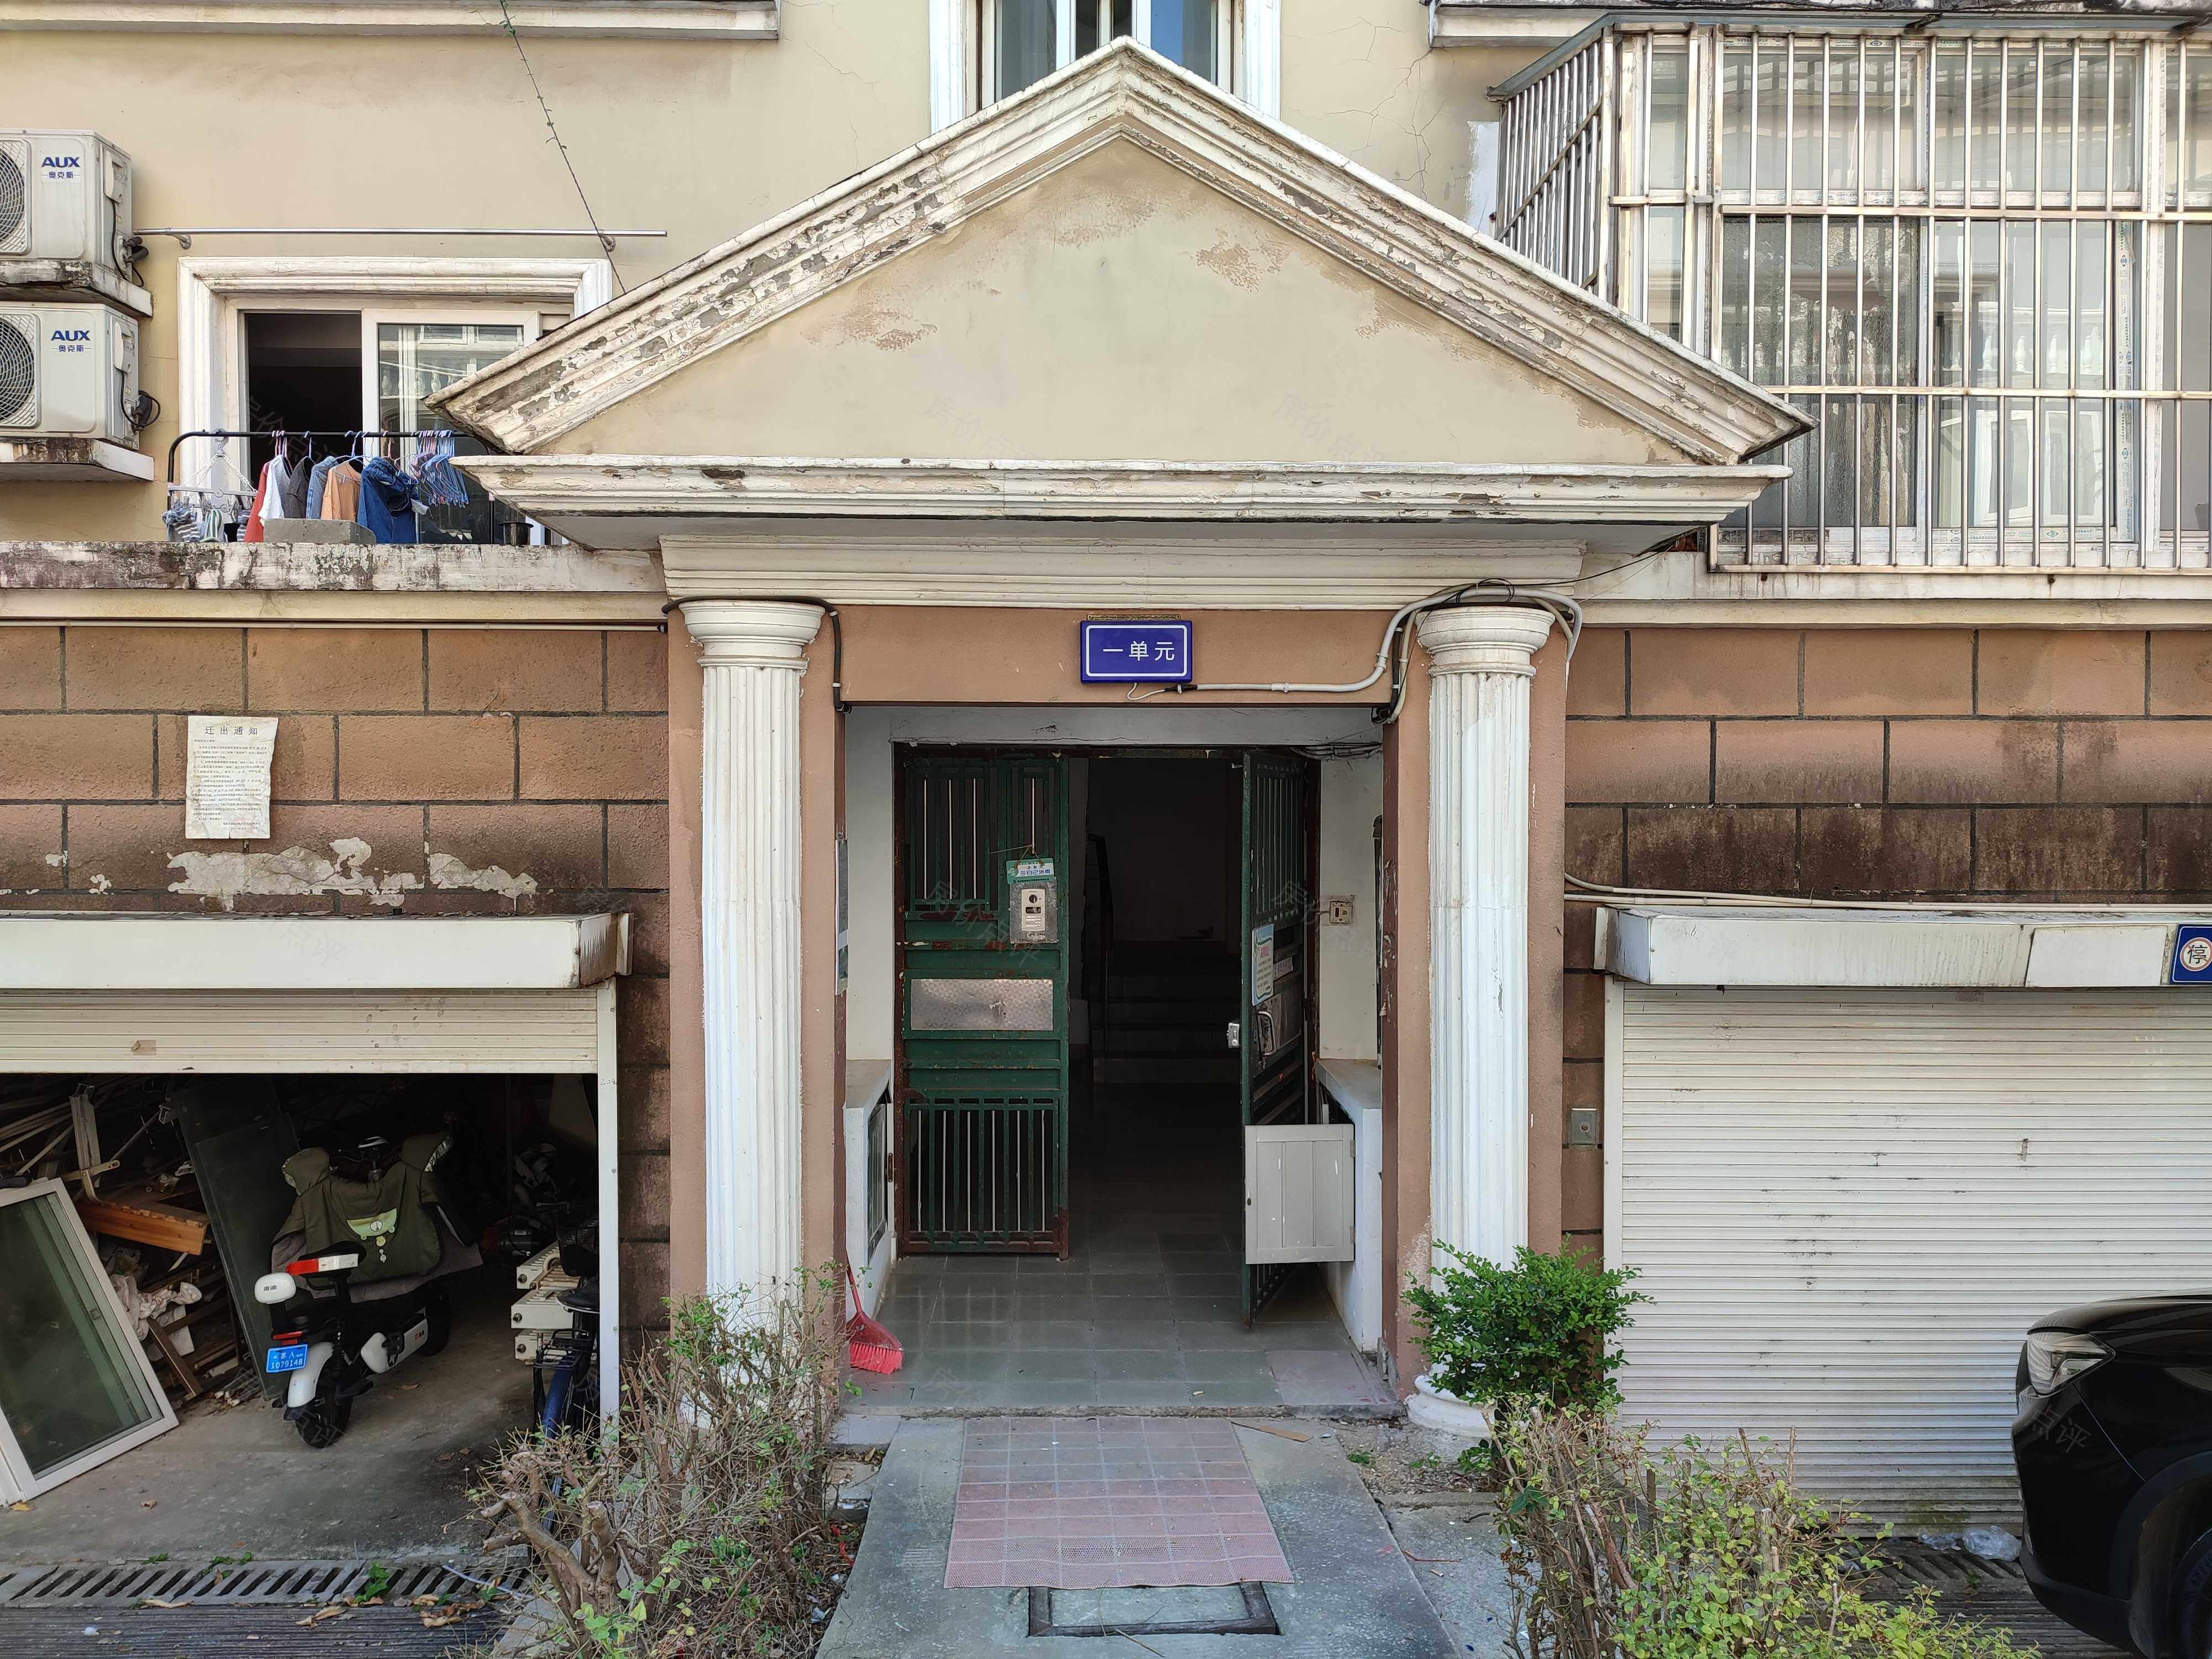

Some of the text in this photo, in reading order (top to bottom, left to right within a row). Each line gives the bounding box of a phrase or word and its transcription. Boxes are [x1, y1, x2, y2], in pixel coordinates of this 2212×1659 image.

[41, 156, 81, 168] AUX
[49, 171, 74, 179] 奥克斯
[50, 330, 91, 341] AUX
[1103, 640, 1175, 661] 一单元
[204, 726, 258, 735] 迁出通知
[2187, 945, 2208, 964] 停
[270, 1359, 303, 1369] 1079148
